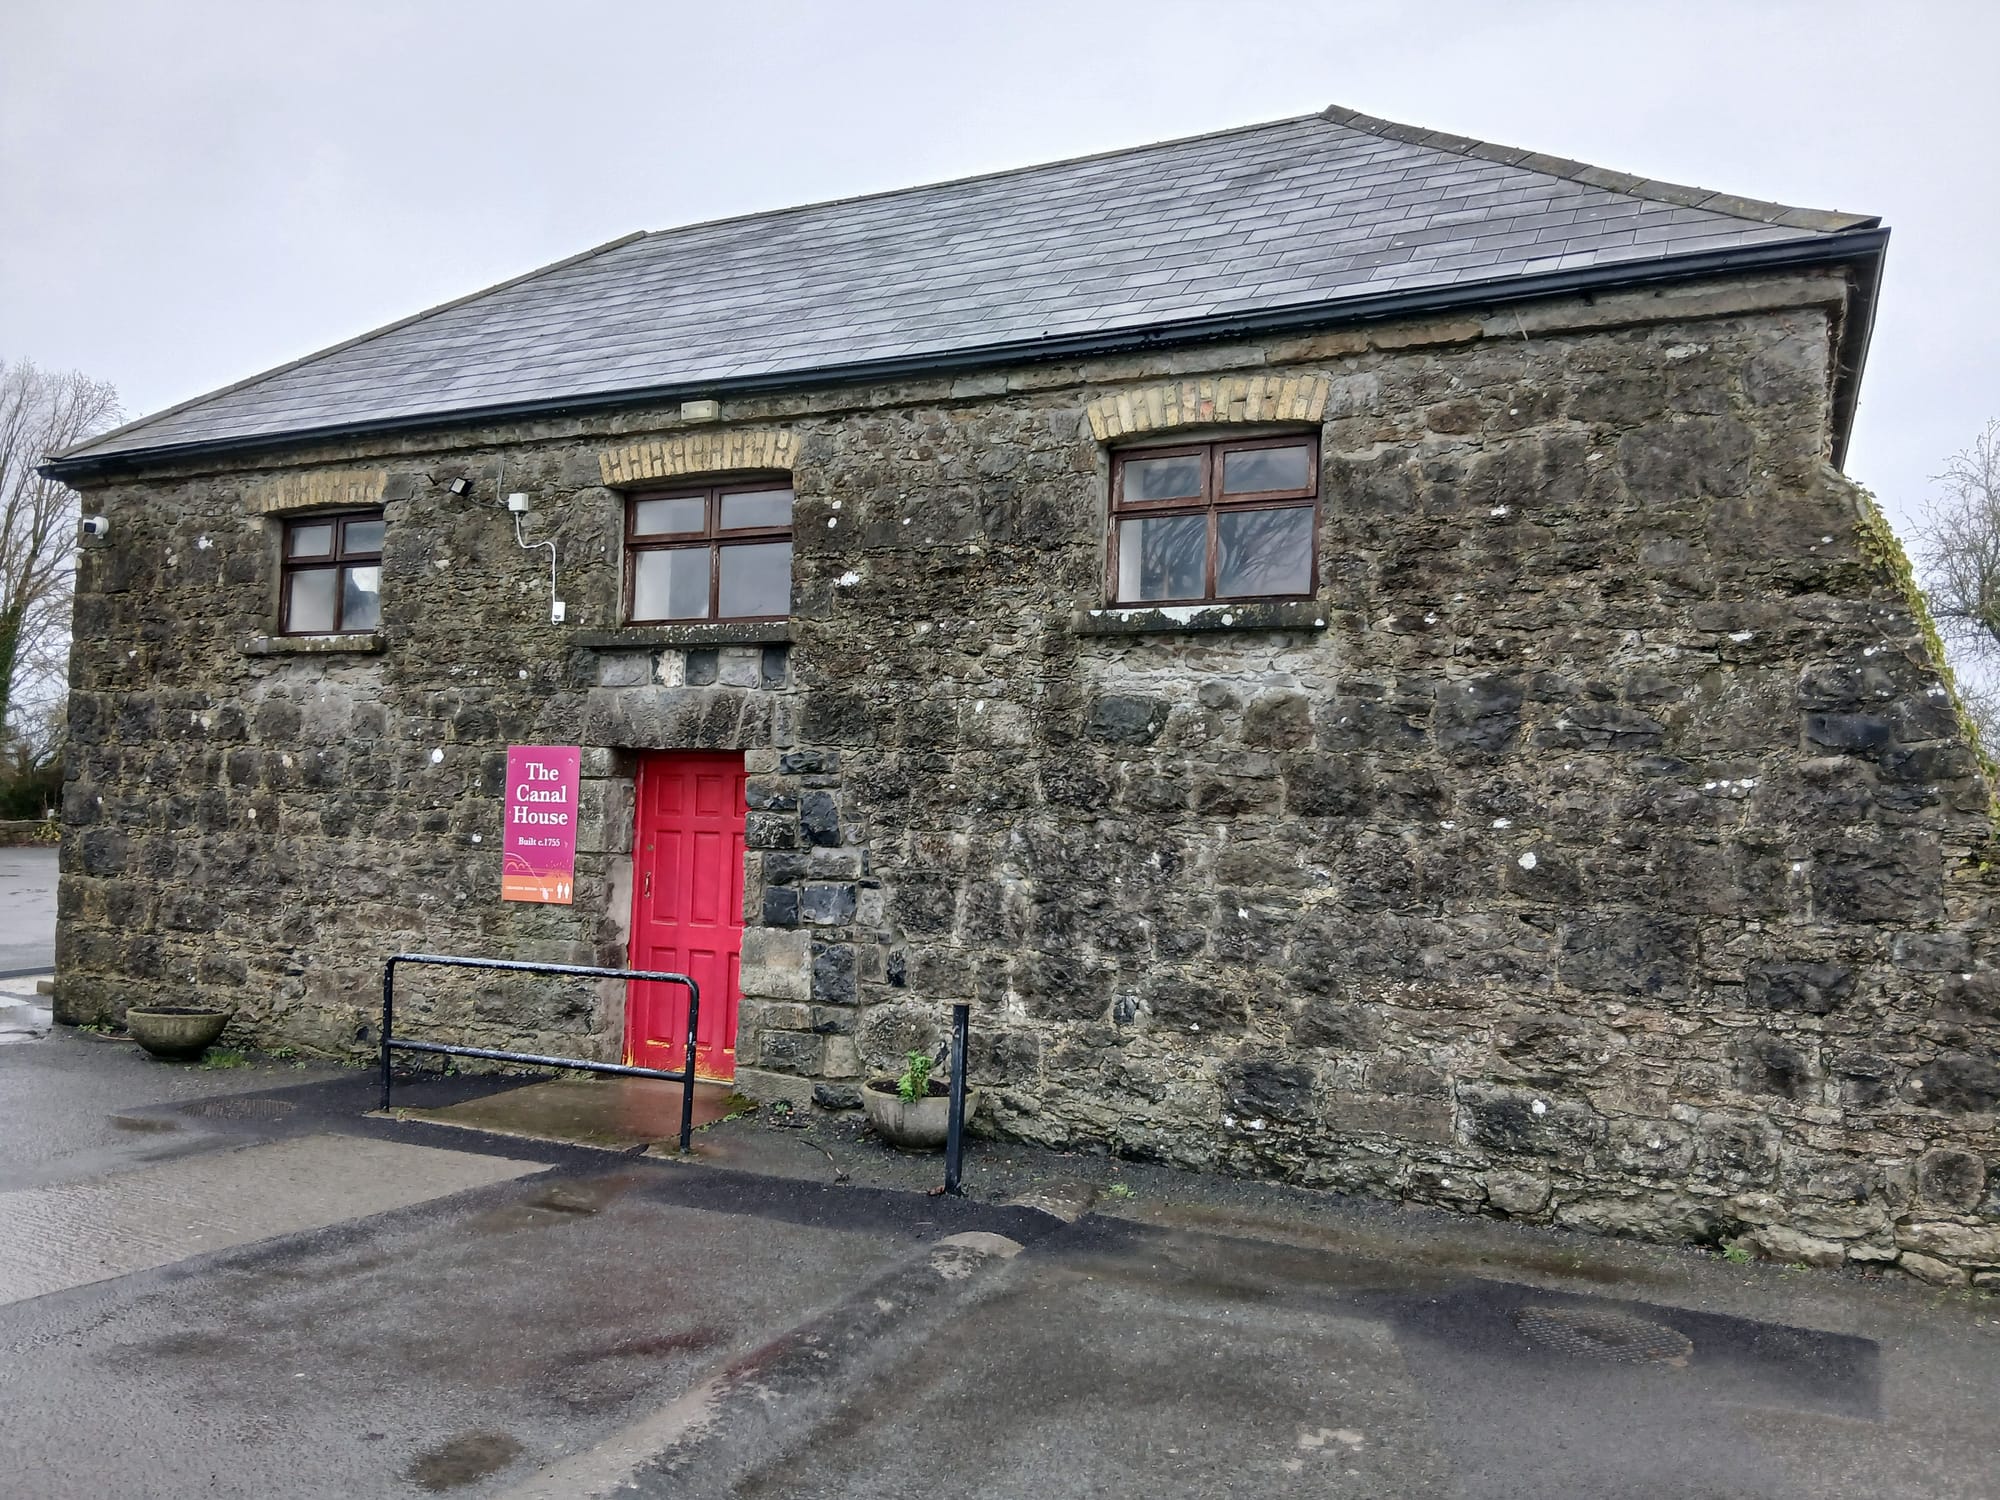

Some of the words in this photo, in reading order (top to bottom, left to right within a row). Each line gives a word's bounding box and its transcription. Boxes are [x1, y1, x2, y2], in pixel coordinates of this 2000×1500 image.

[526, 762, 559, 781] The
[516, 784, 567, 803] Canal
[512, 805, 568, 825] House
[518, 836, 537, 846] Built
[537, 838, 561, 847] c.1755
